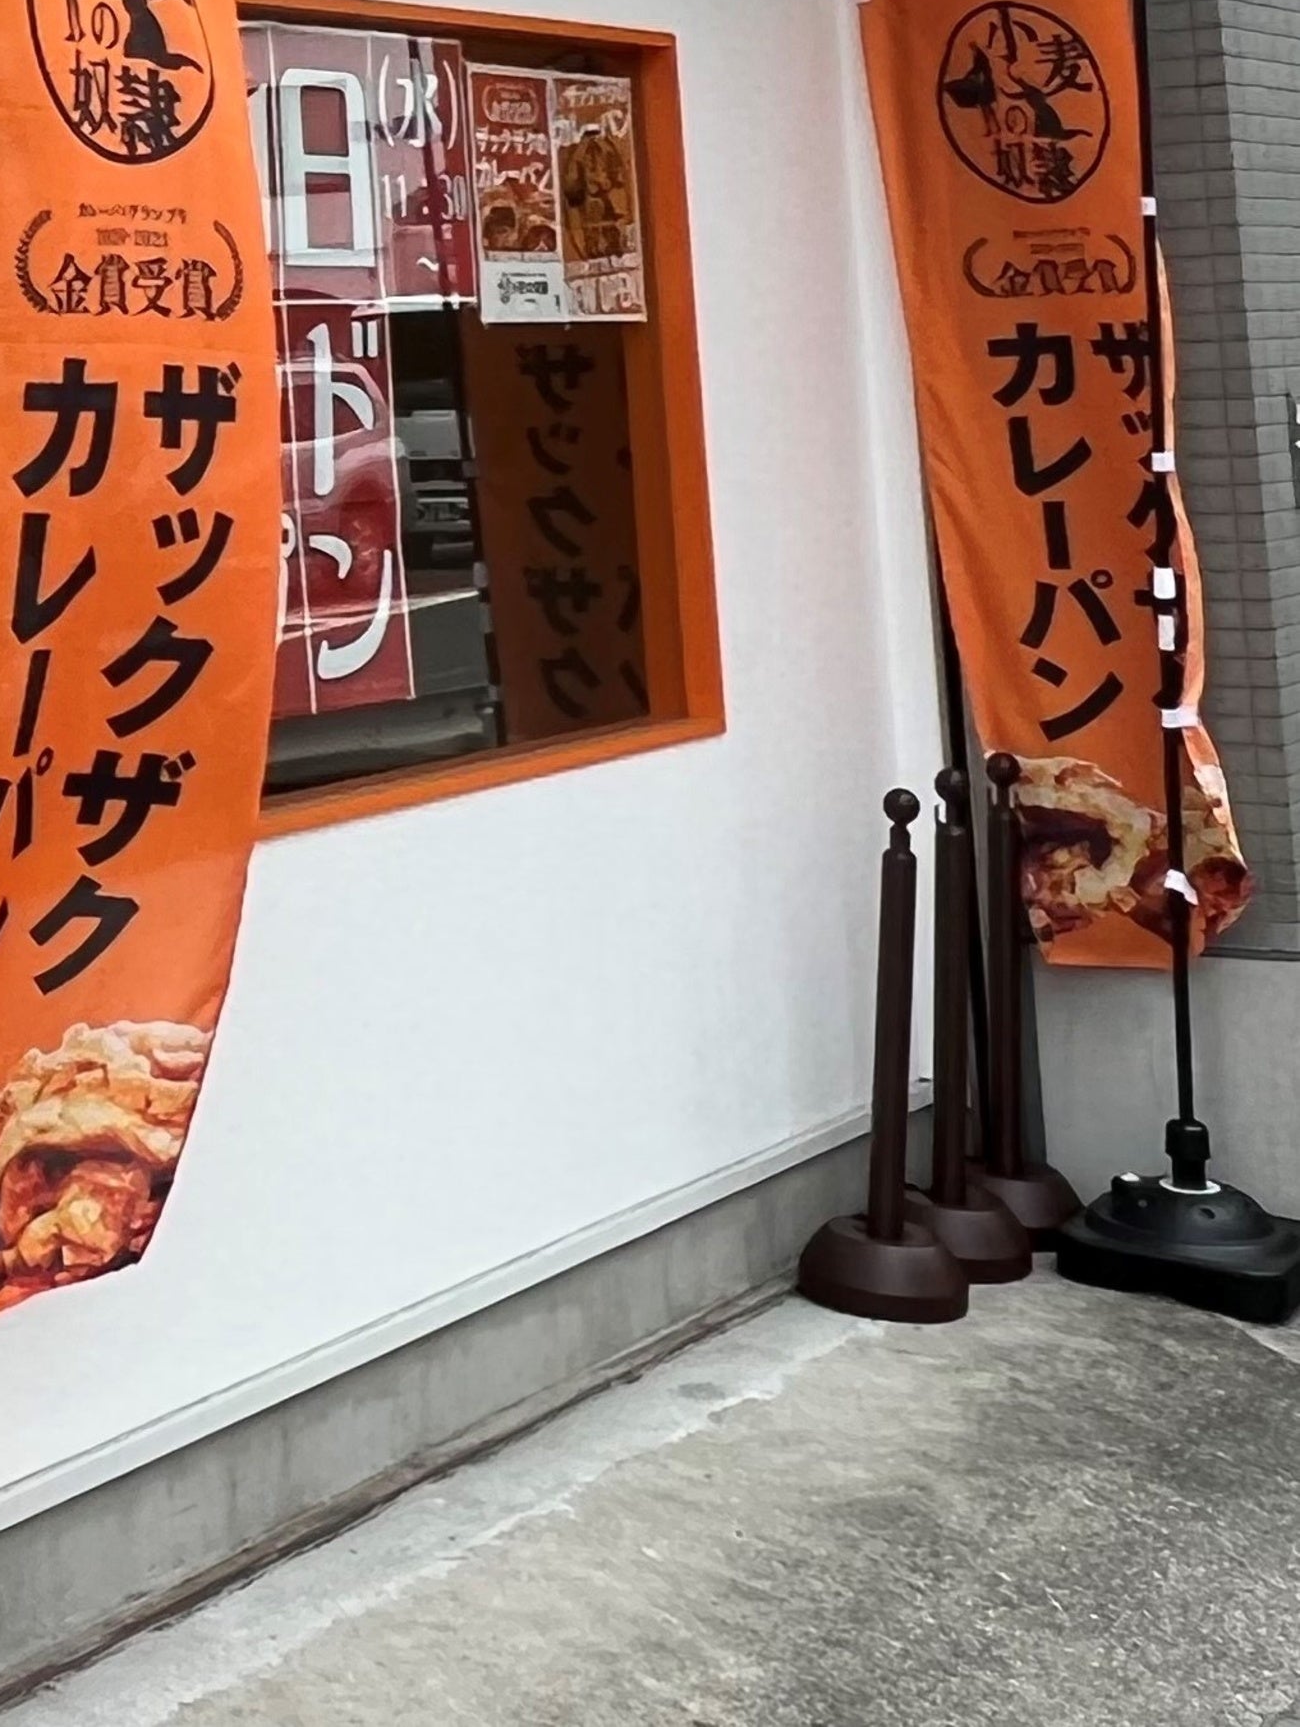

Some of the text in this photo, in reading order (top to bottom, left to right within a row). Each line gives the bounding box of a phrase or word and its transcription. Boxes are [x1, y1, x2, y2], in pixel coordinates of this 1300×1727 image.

[91, 1, 119, 49] の
[28, 360, 244, 997] ザックザク
[985, 320, 1126, 744] カレーパン
